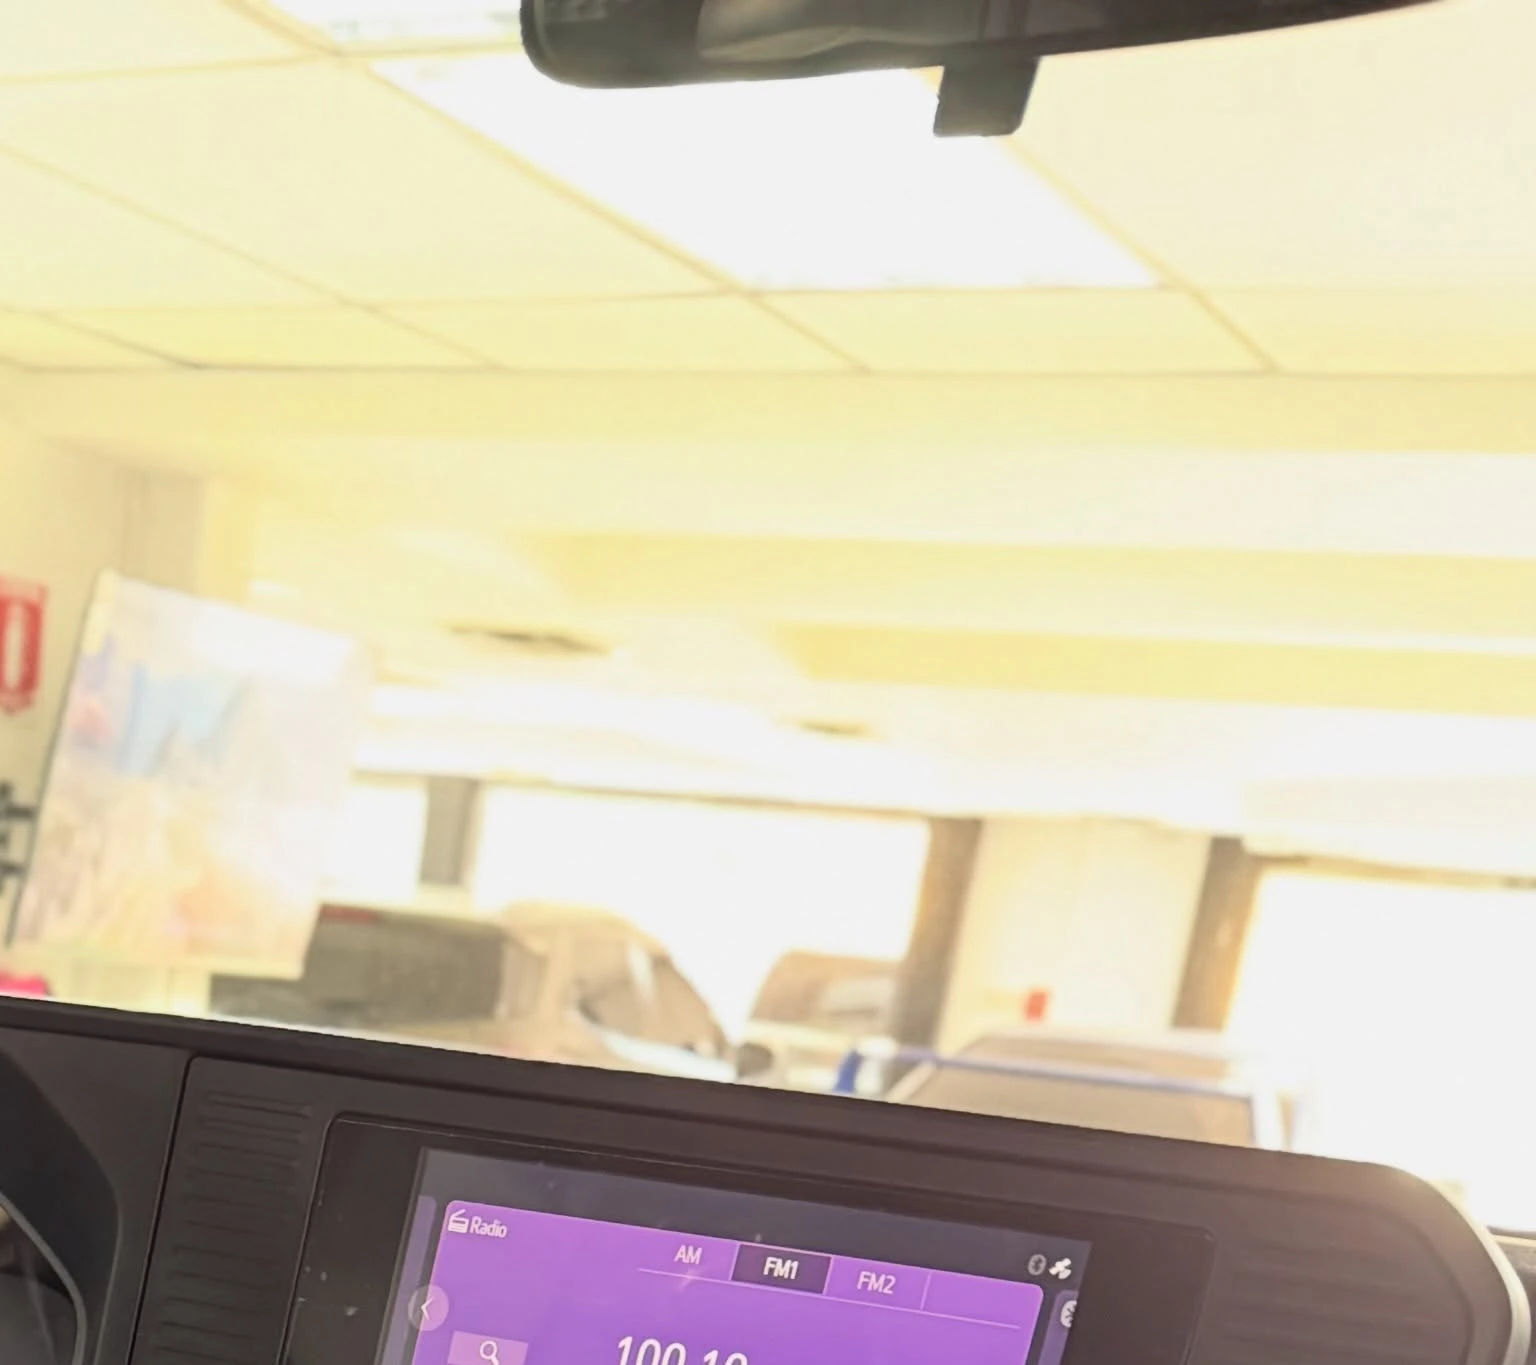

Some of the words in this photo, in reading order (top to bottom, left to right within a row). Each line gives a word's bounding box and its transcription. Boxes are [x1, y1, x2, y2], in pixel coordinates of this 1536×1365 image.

[469, 1216, 507, 1239] Radio
[674, 1245, 702, 1265] AM
[763, 1256, 799, 1280] FM1
[856, 1271, 896, 1294] FM2
